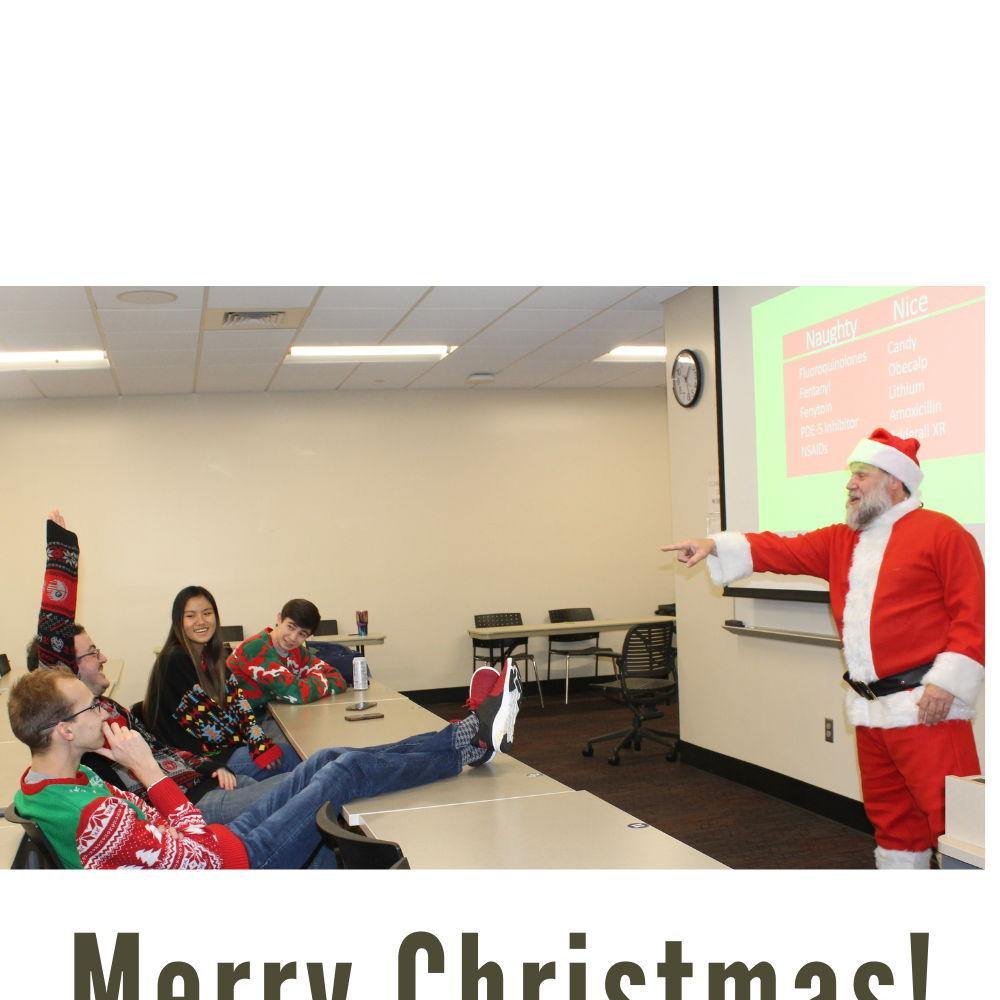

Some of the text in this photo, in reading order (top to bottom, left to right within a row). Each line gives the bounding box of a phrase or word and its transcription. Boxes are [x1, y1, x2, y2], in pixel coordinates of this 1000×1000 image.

[893, 295, 929, 321] Nice
[806, 318, 859, 349] Naughty
[887, 336, 917, 355] Candy
[889, 355, 928, 376] Obecalp
[889, 381, 925, 400] Lithium
[889, 400, 943, 421] Amoxicillin
[932, 421, 947, 437] XR
[801, 441, 828, 457] NSAIDs
